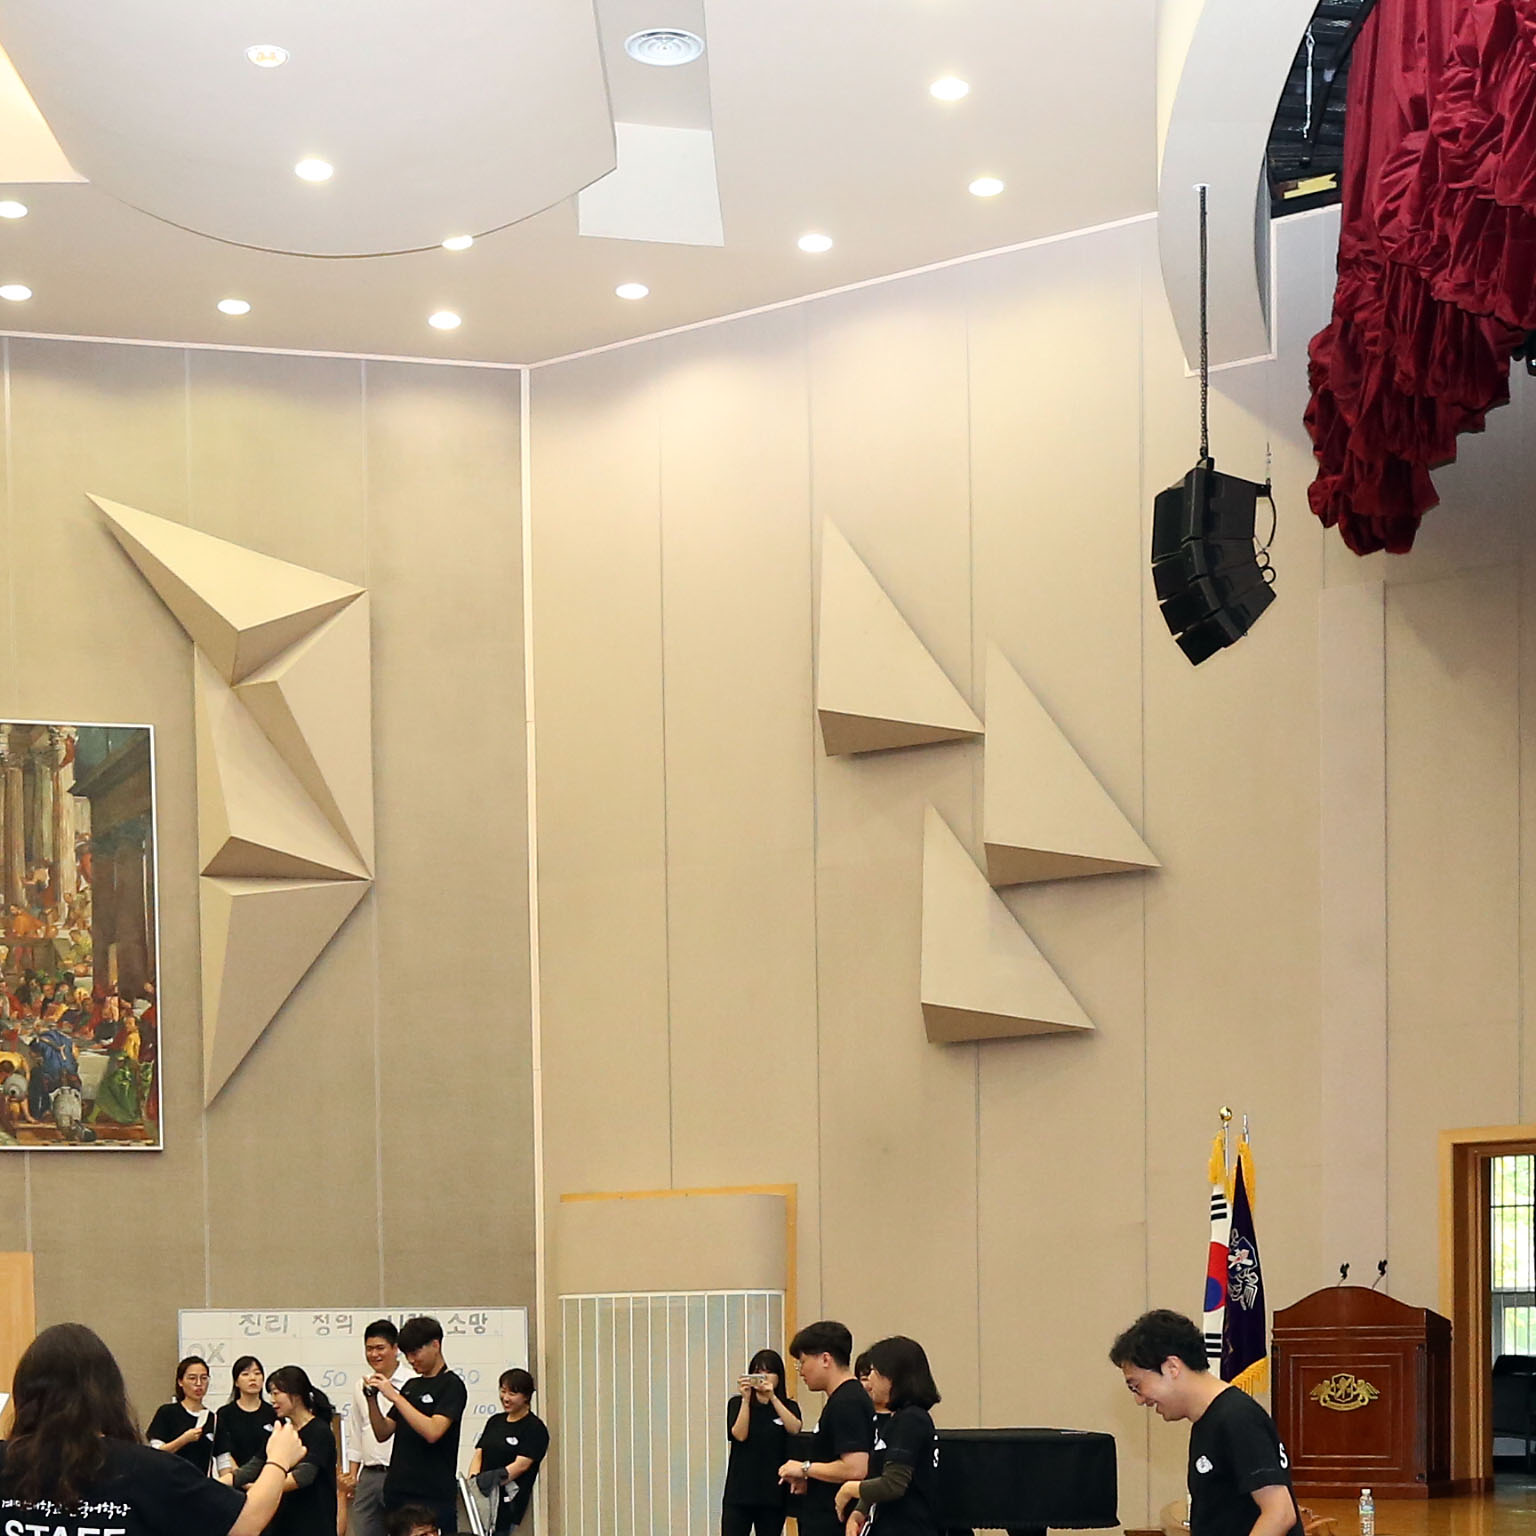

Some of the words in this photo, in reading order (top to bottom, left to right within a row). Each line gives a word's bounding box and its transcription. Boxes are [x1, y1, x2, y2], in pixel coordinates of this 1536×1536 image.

[239, 1313, 289, 1337] 진리
[312, 1313, 353, 1337] 정의
[447, 1312, 488, 1335] 소망
[321, 1369, 347, 1388] 50
[473, 1403, 497, 1415] 100
